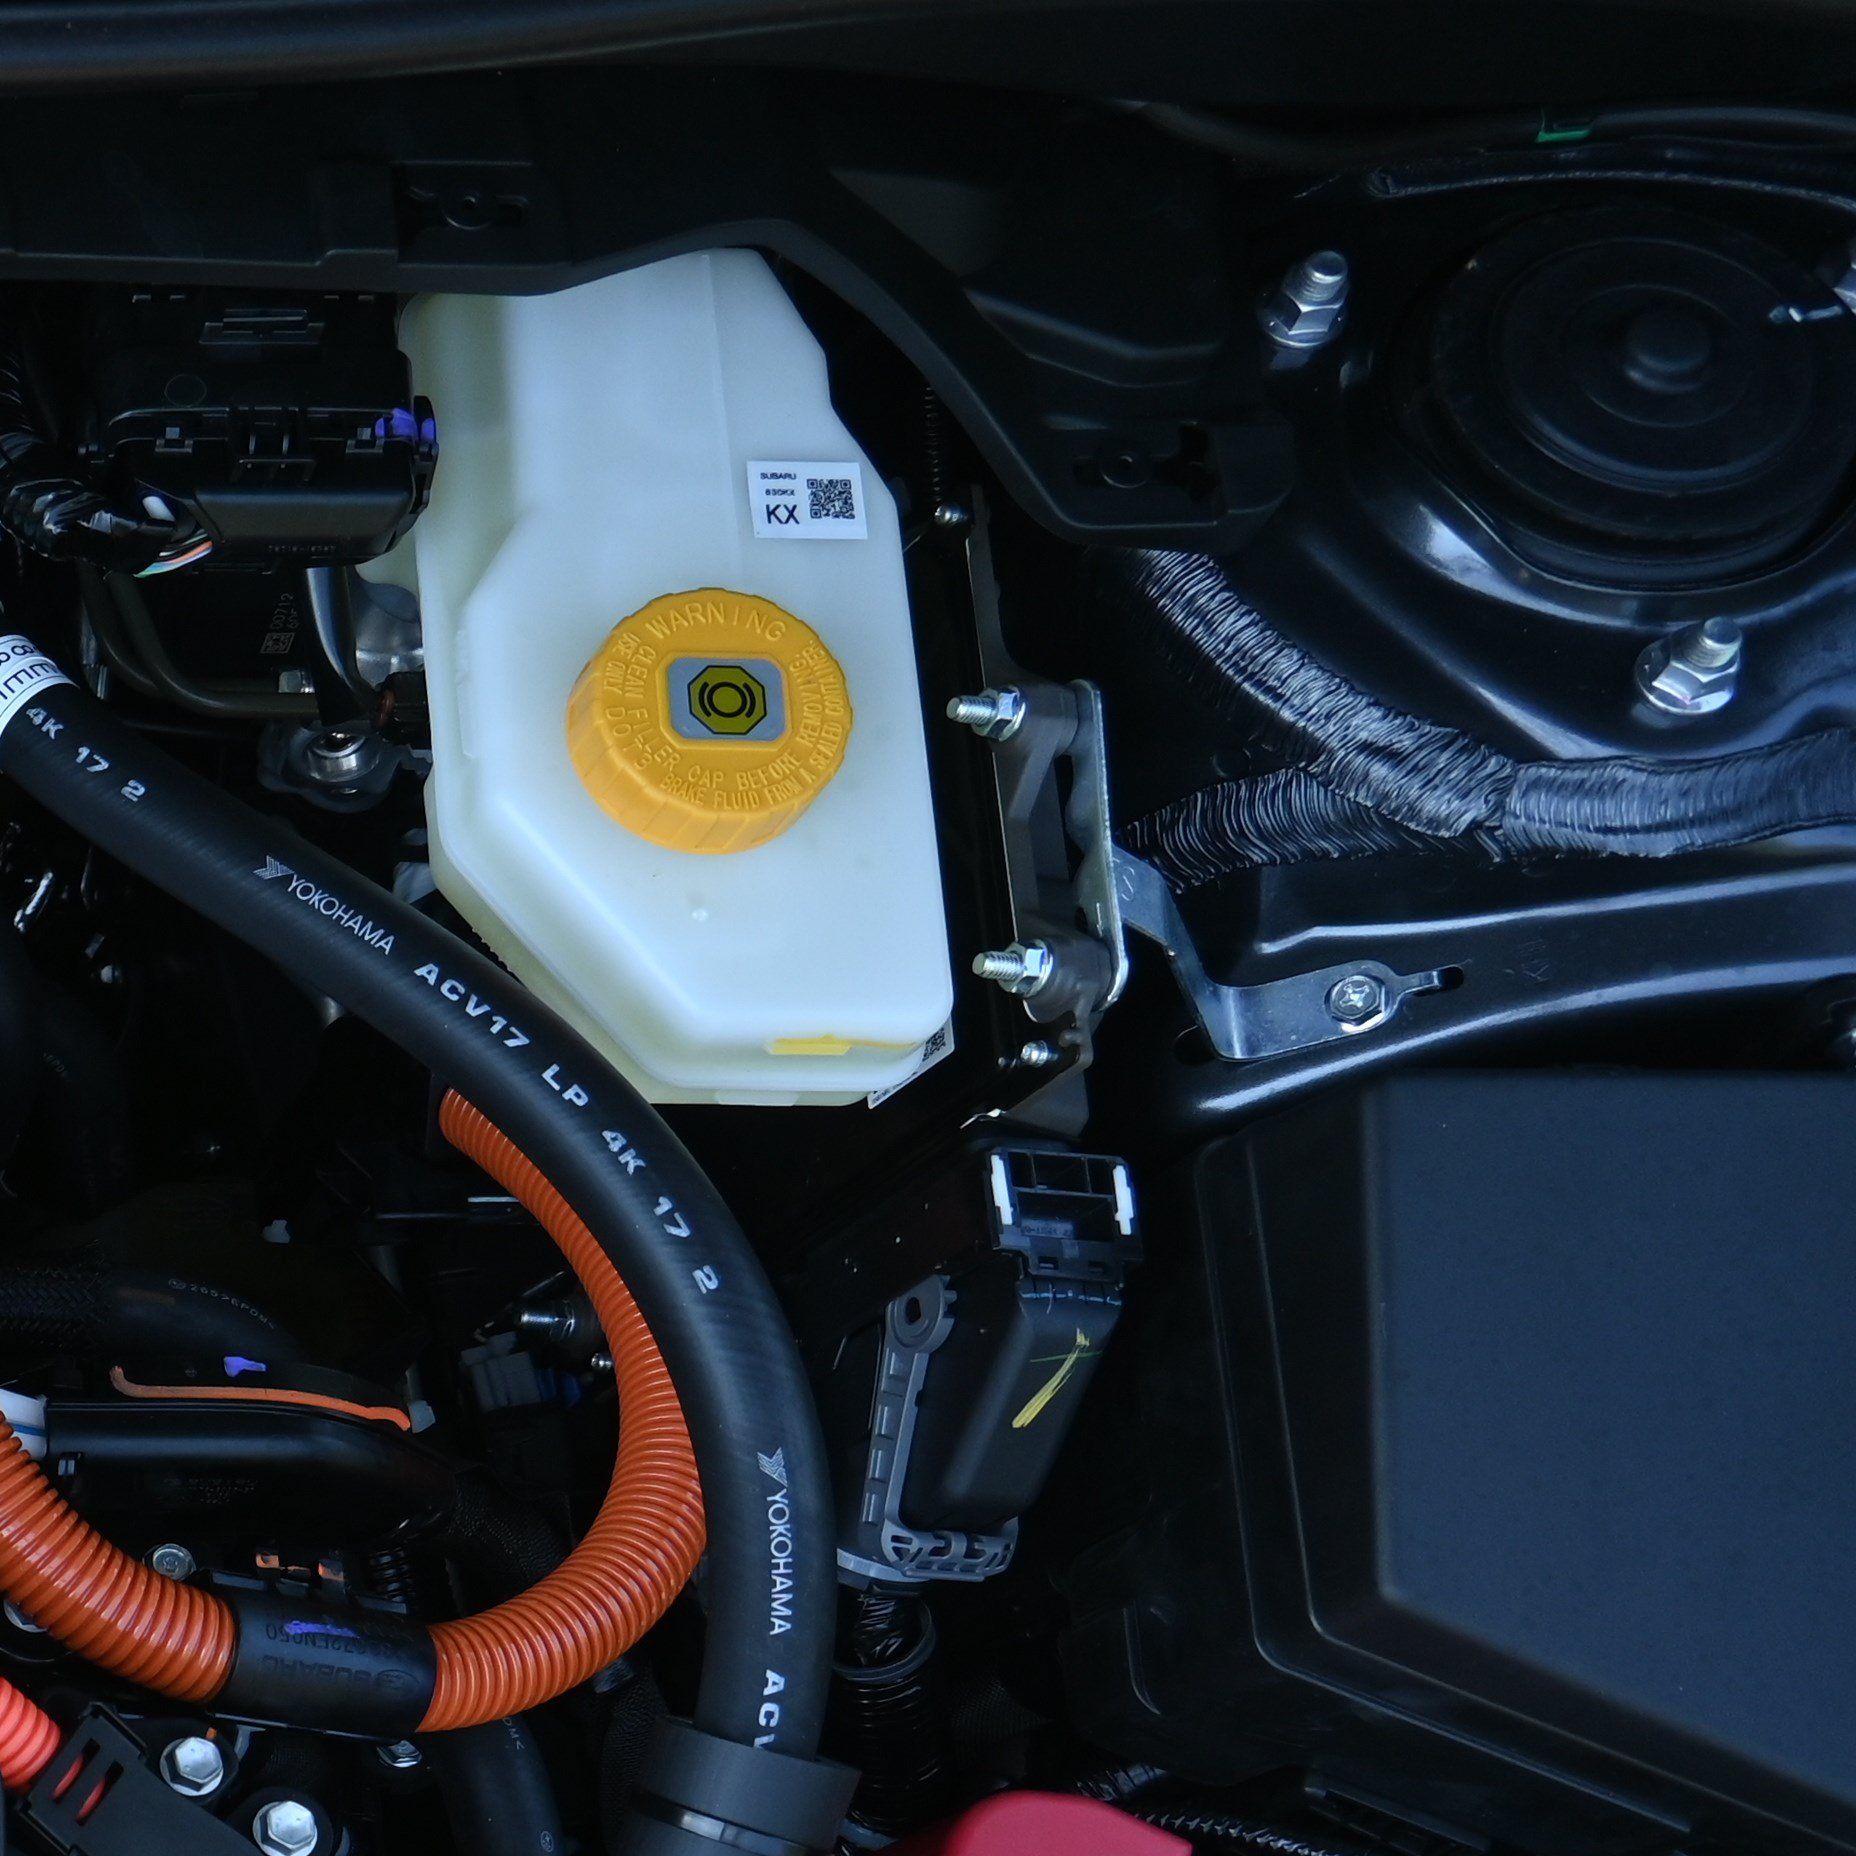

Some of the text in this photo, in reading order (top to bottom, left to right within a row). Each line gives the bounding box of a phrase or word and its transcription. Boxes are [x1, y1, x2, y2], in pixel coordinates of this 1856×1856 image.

[760, 472, 797, 480] SUBARU
[766, 504, 800, 524] KX
[645, 600, 786, 645] WARNING
[120, 778, 147, 802] 2
[687, 765, 724, 788] CAP
[737, 752, 803, 791] BEFORE
[659, 773, 707, 807] BRAKE
[713, 791, 760, 811] FLUID
[287, 872, 720, 1296] YOKOHAMA ACV17 LP 4K 17 2
[752, 1487, 794, 1750] YOKOHAMA ACV
